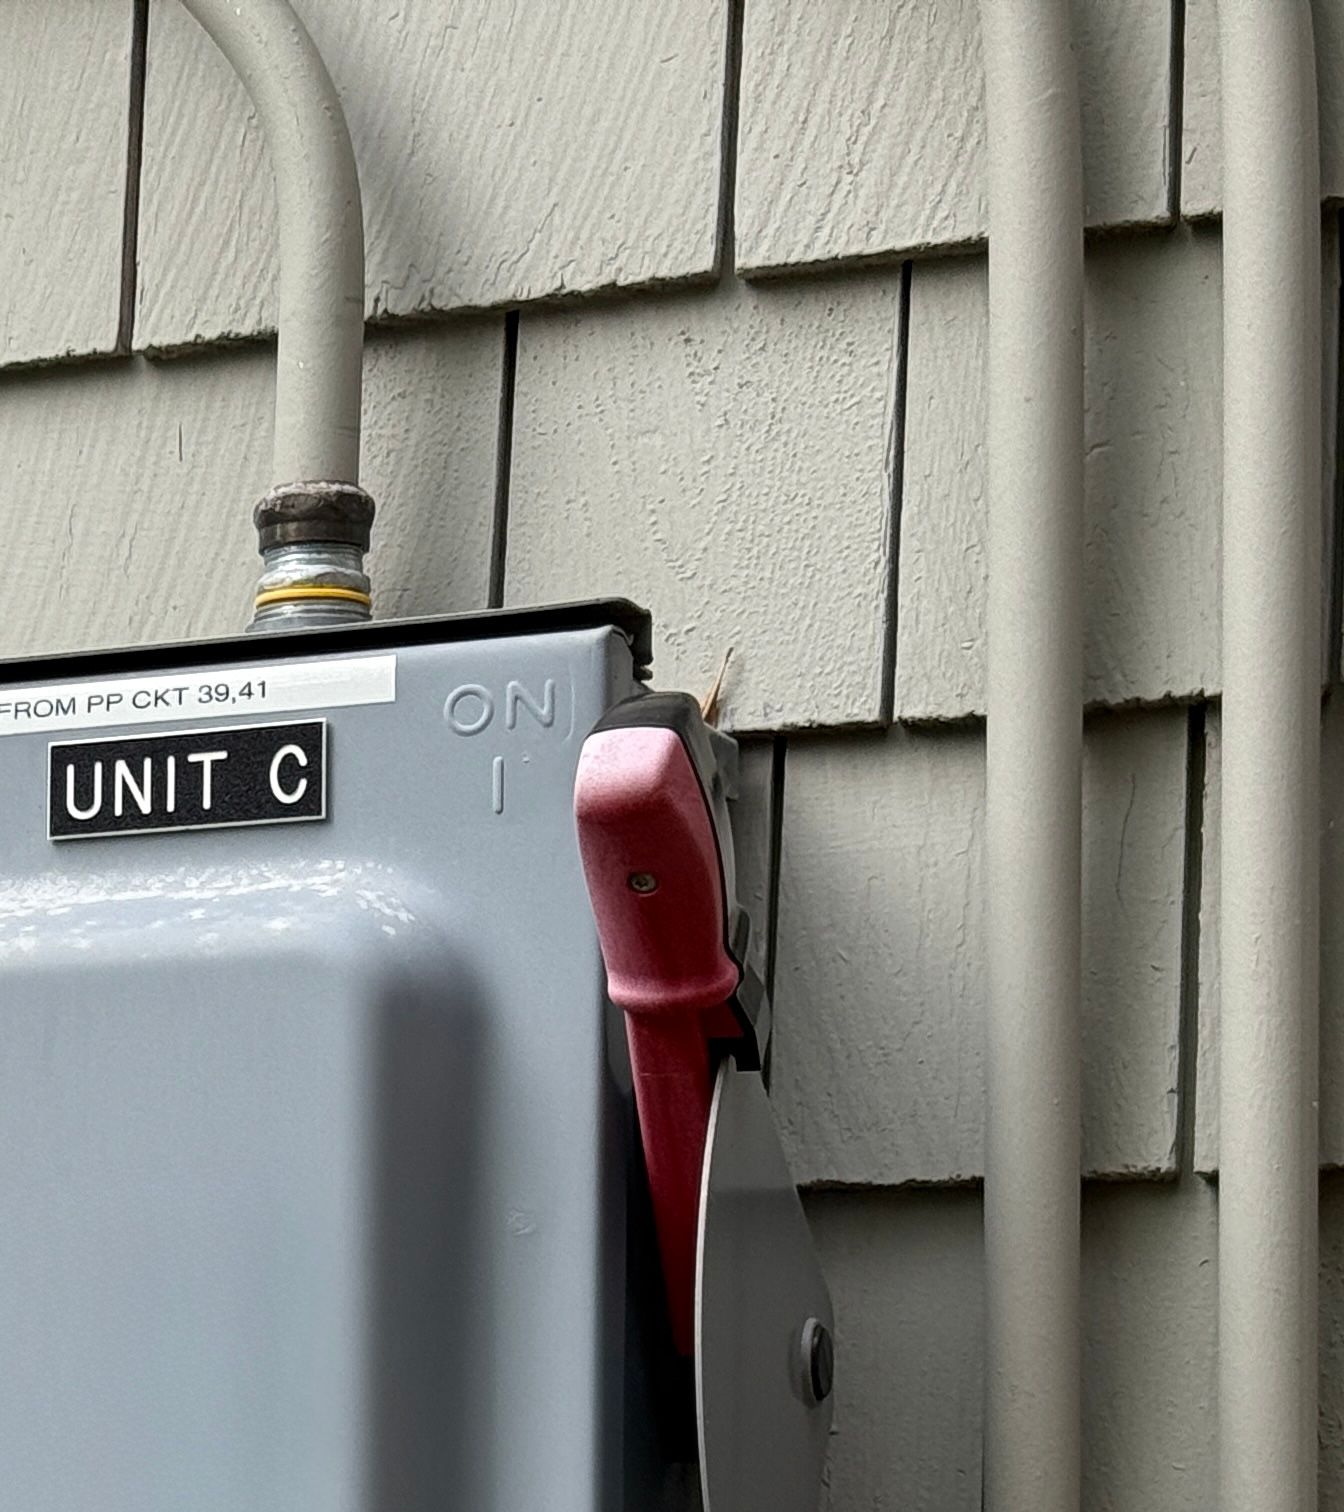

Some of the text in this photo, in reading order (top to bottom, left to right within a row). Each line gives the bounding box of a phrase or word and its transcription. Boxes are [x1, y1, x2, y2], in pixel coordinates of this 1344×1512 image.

[87, 692, 123, 714] PP
[131, 687, 189, 708] CKT
[198, 680, 268, 704] 39,41
[444, 679, 555, 737] ON
[65, 743, 309, 821] UNIT C
